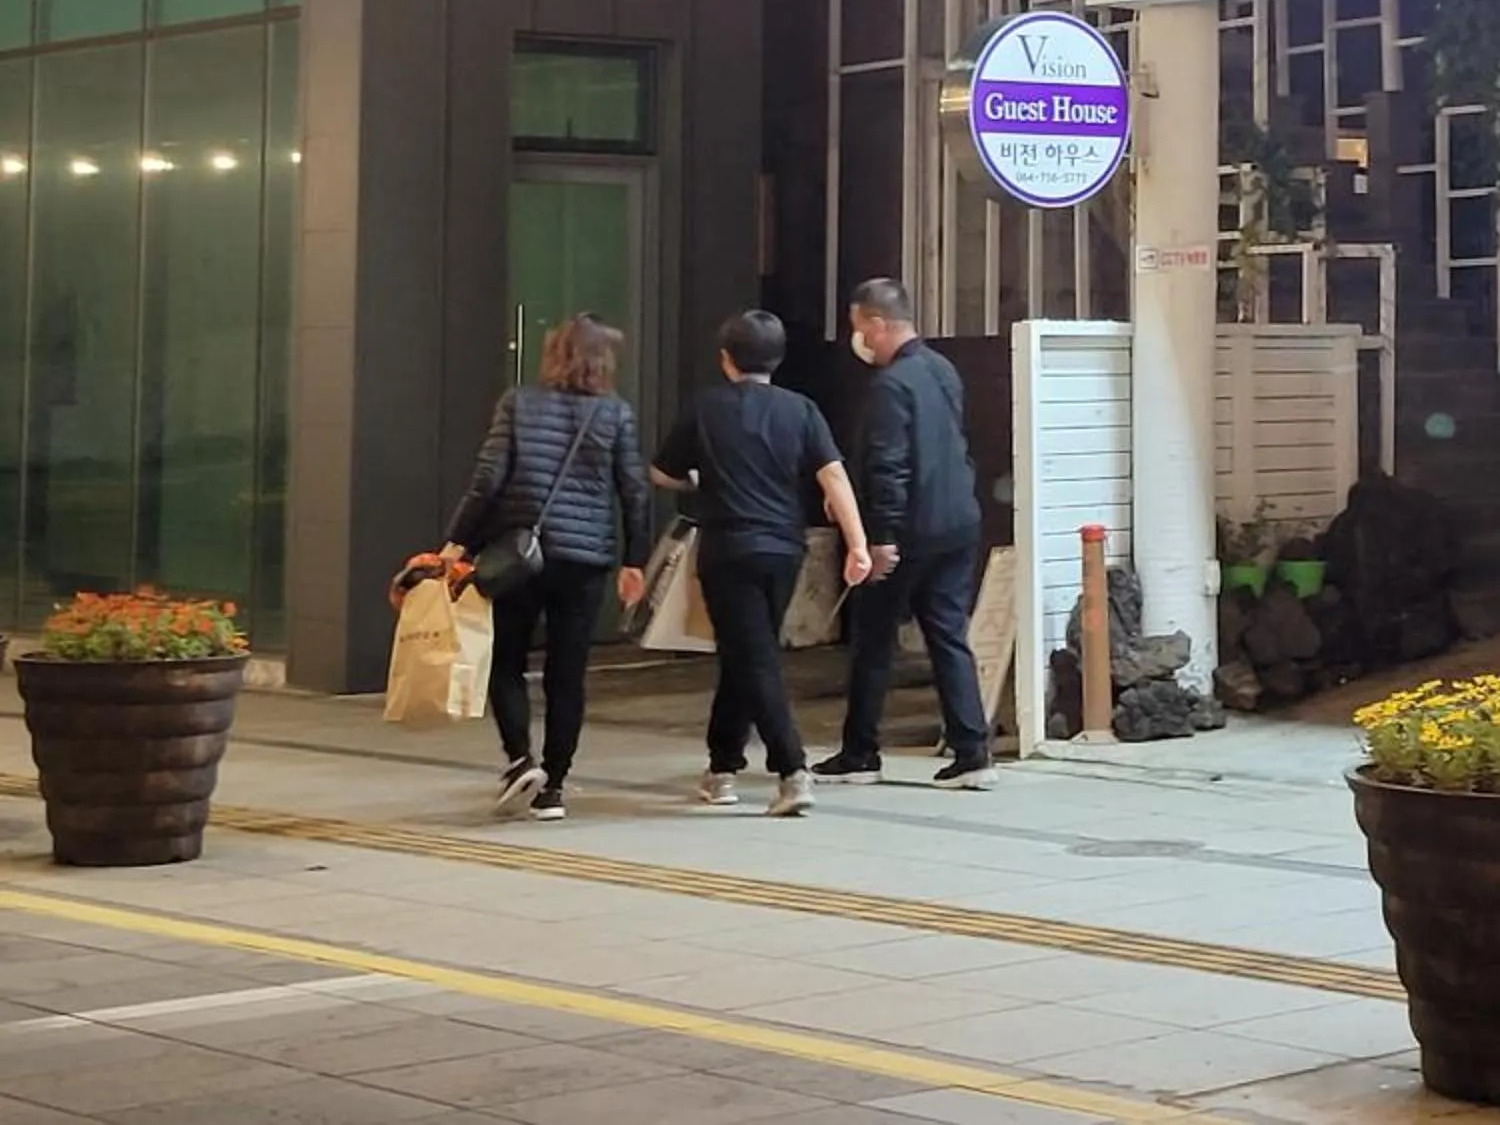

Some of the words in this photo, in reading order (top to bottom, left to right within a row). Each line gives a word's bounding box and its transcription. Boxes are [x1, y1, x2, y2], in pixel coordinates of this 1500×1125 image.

[1017, 34, 1087, 79] Vision
[985, 92, 1048, 122] Guest
[1052, 95, 1119, 125] House
